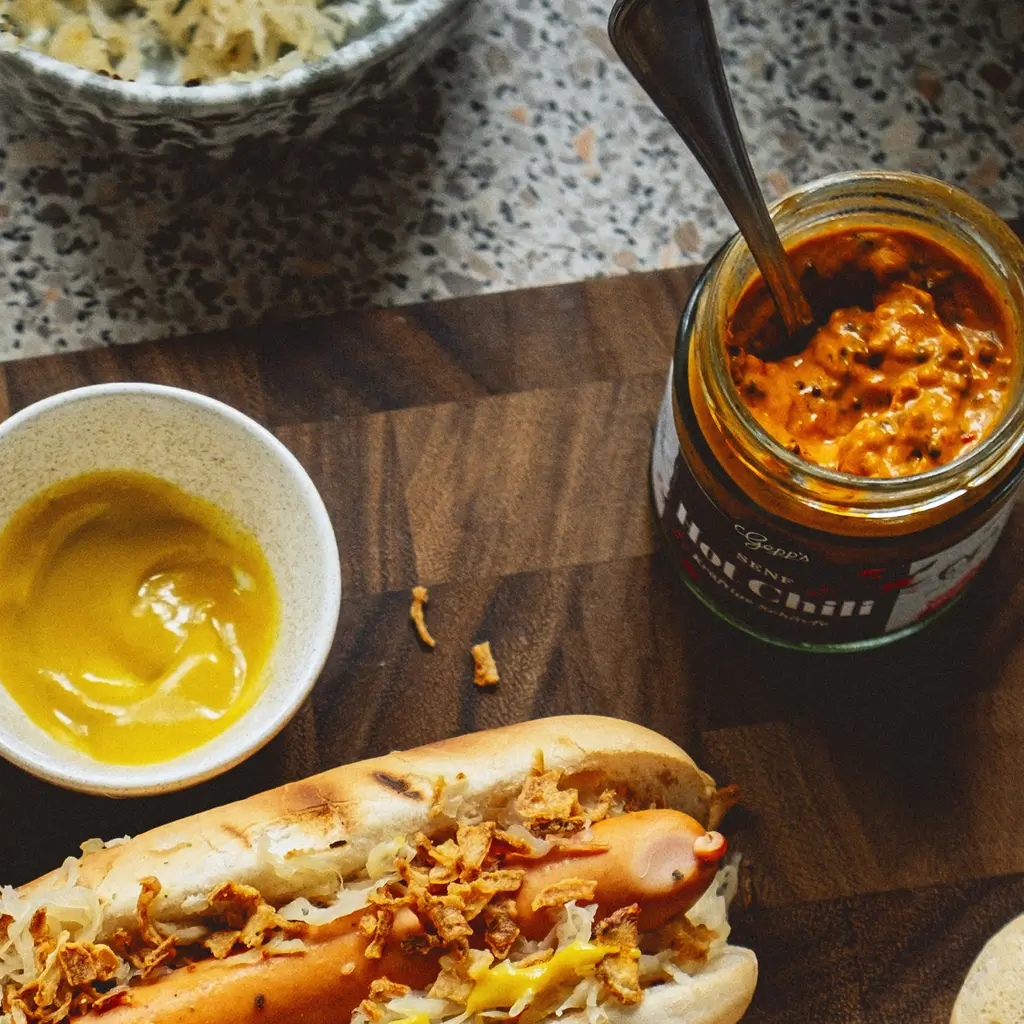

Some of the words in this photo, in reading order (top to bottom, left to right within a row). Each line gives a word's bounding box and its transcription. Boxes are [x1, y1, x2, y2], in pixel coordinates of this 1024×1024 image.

[734, 524, 810, 562] Gepp's
[736, 552, 795, 584] SENF
[748, 579, 875, 617] Chili
